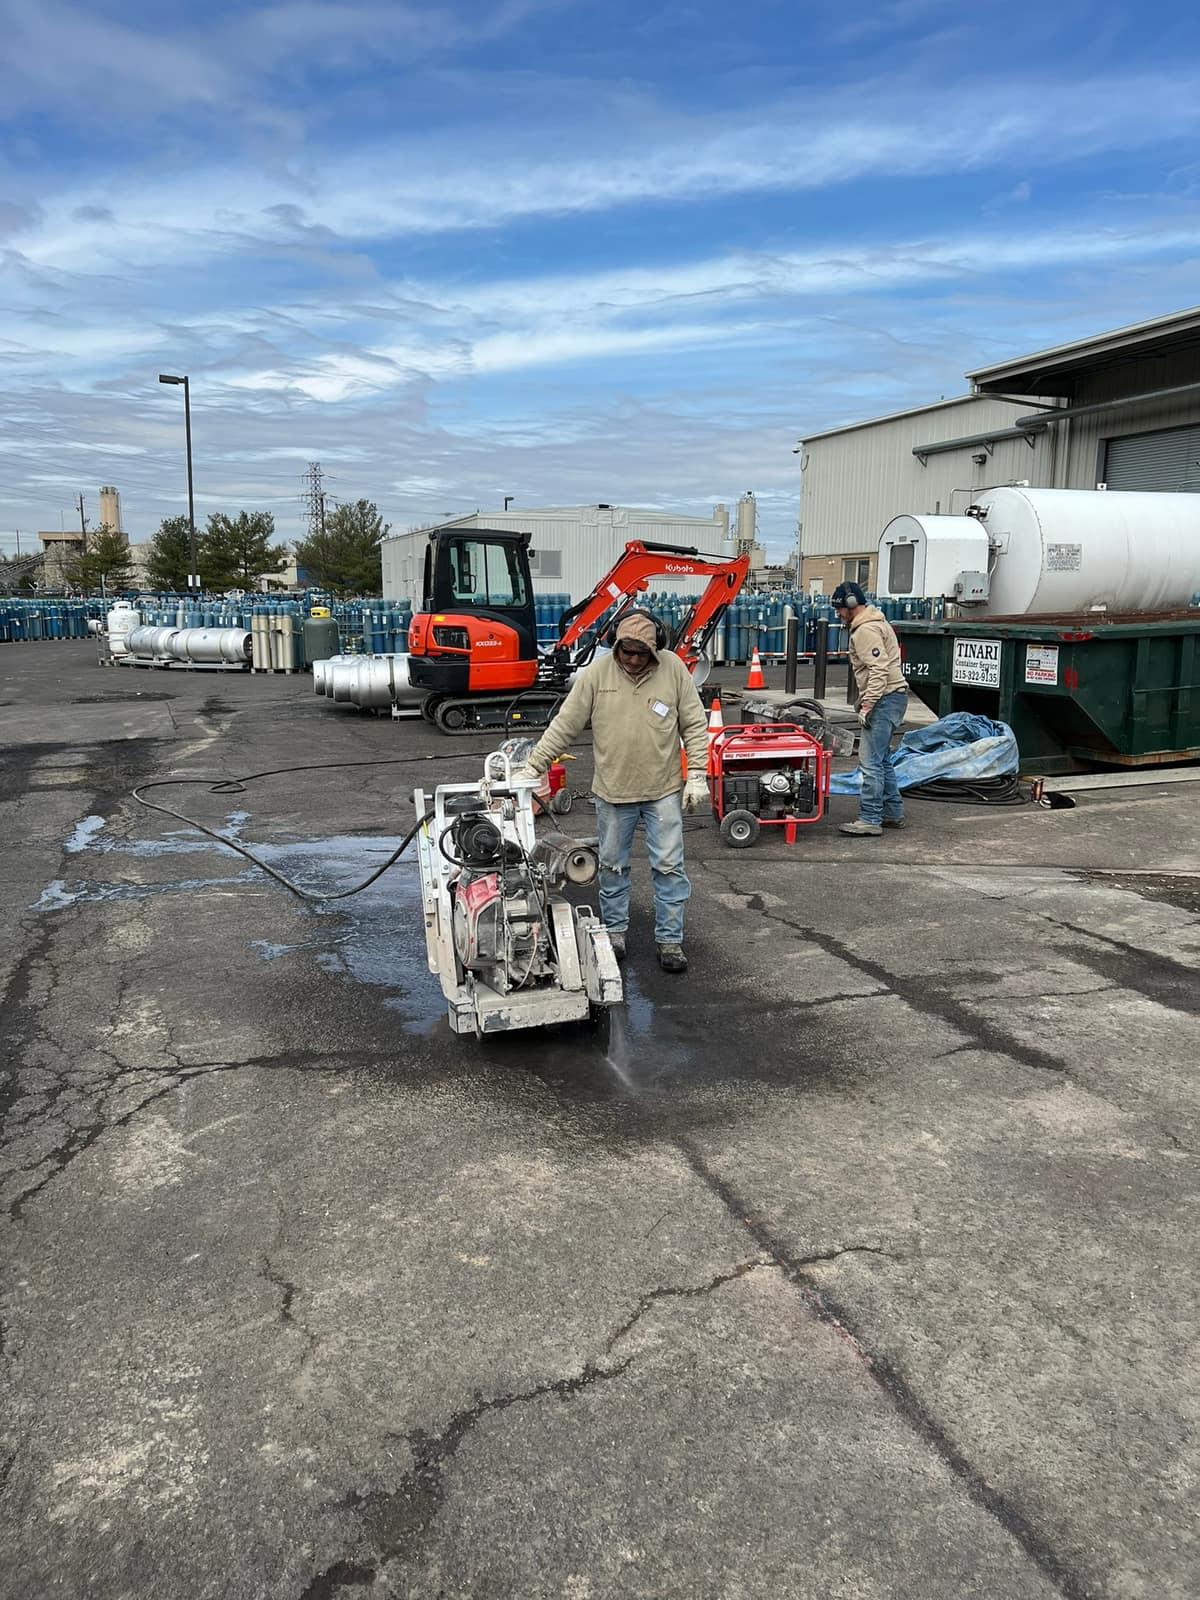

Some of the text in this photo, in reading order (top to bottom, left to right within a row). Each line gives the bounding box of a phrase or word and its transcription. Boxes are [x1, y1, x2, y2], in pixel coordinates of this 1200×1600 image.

[665, 563, 694, 573] Kubota
[957, 643, 998, 660] TINARI
[955, 659, 998, 671] Container Service
[955, 669, 998, 683] 215-322-9135
[1035, 671, 1056, 679] PARKING
